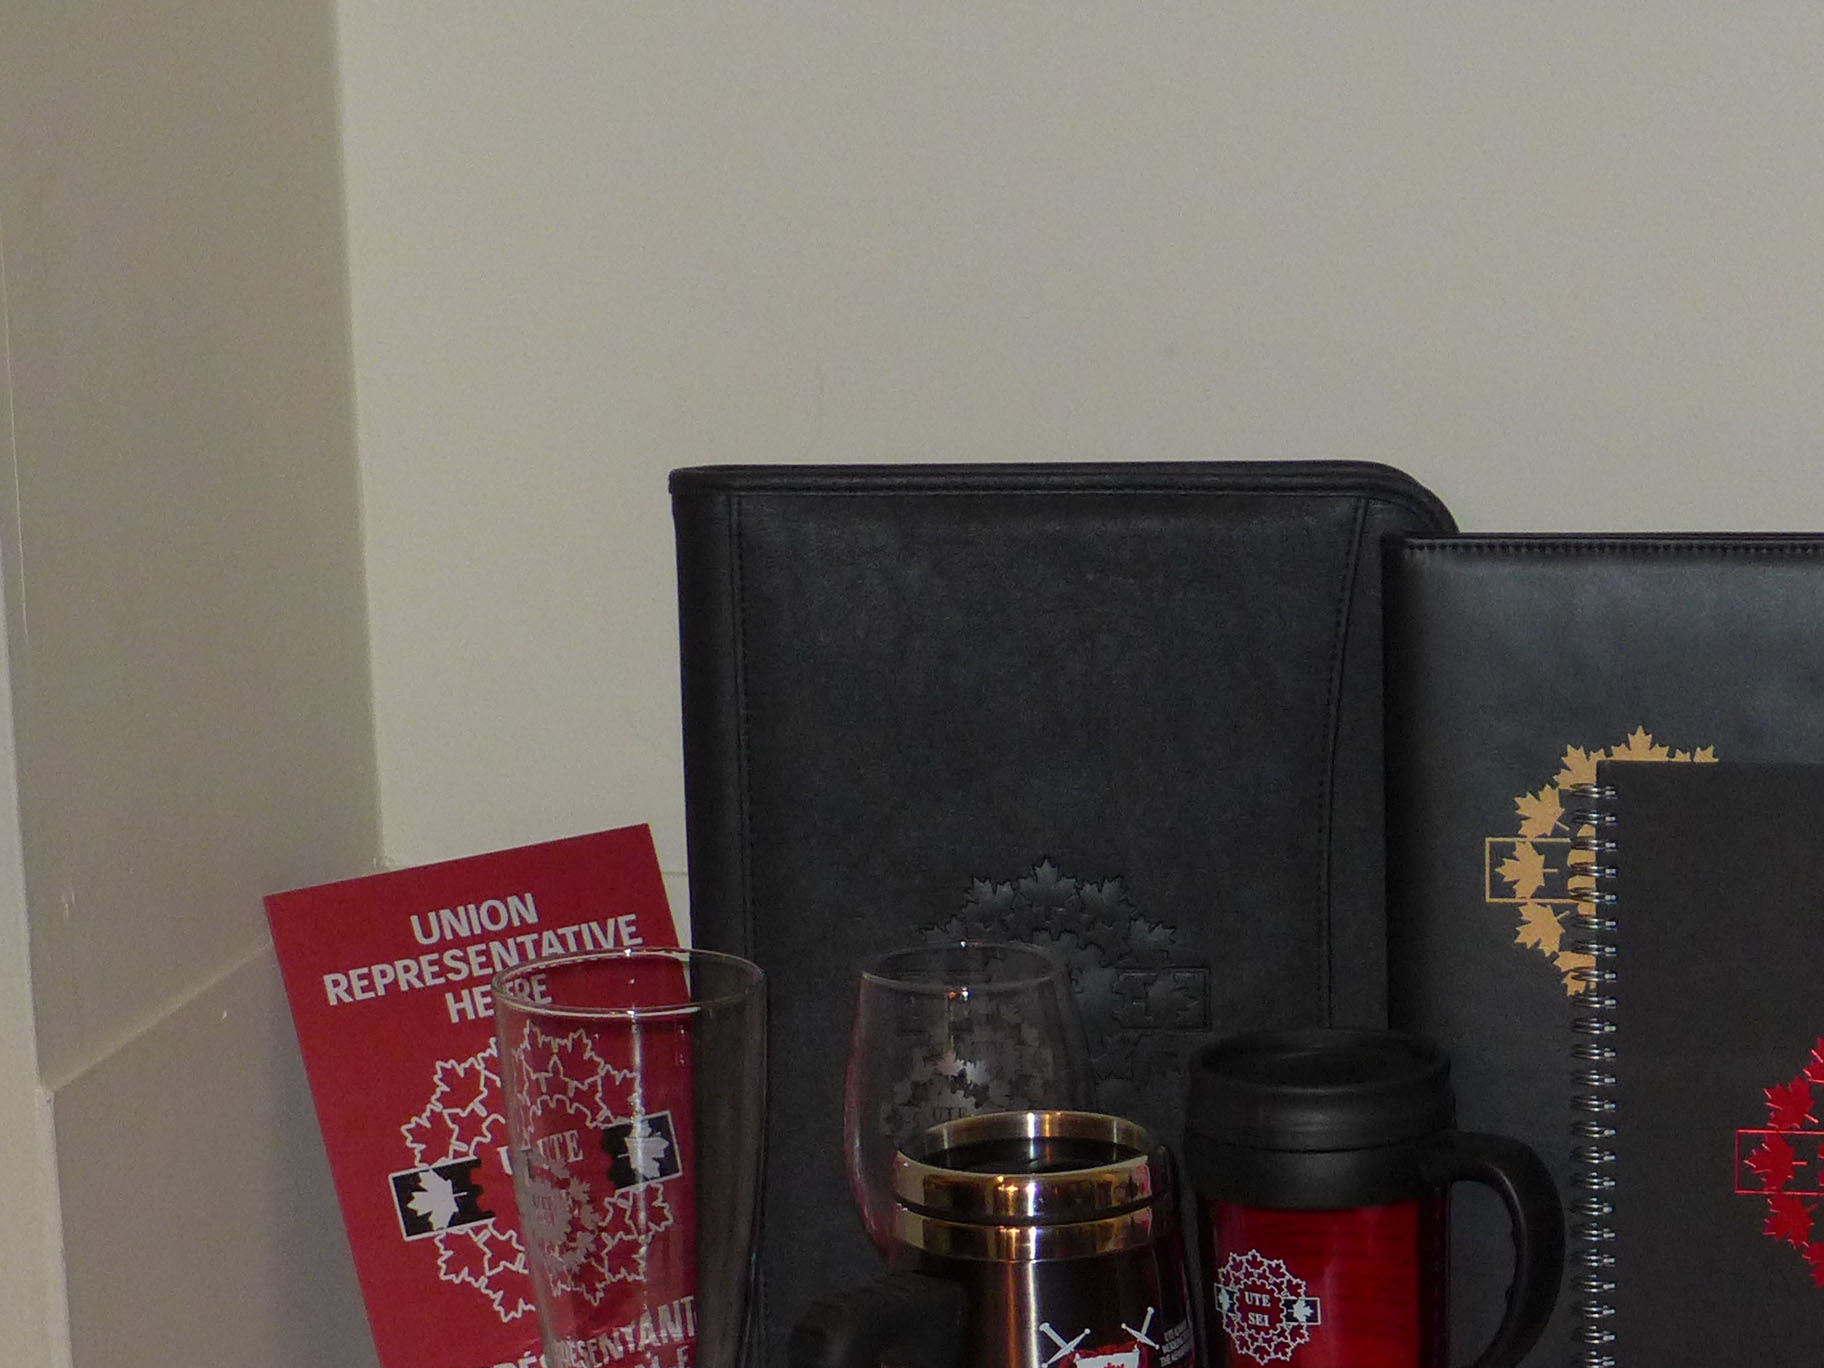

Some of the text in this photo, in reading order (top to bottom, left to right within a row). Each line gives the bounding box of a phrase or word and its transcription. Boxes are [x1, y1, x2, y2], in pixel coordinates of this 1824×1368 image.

[410, 893, 538, 945] UNION
[323, 914, 644, 1006] REPRESENTATIVE
[1244, 1291, 1271, 1308] UTE
[1247, 1312, 1270, 1327] SEI
